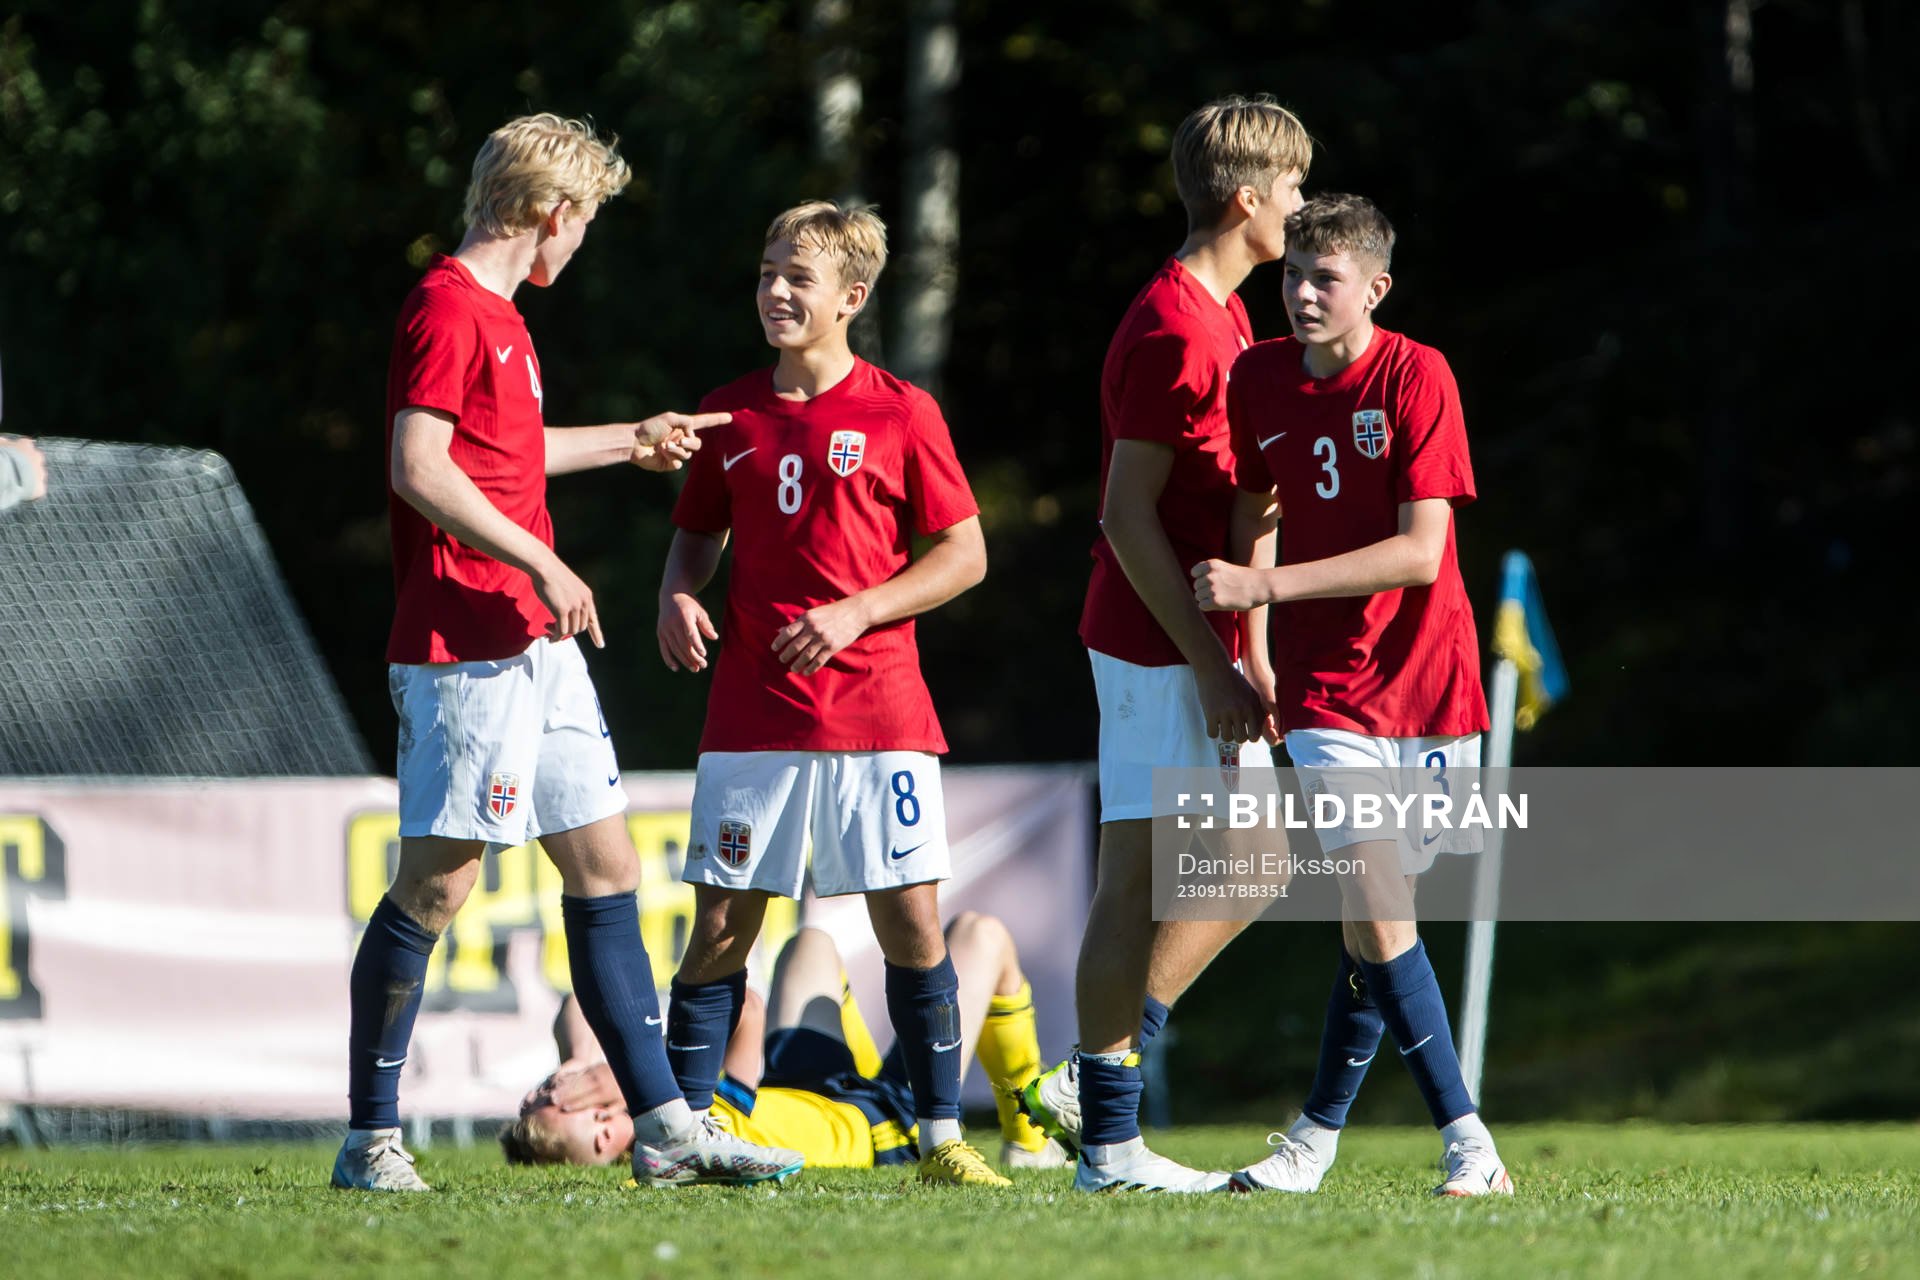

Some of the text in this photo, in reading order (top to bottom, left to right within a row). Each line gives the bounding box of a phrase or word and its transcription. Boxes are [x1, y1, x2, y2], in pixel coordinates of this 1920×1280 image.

[777, 454, 803, 515] 8
[1313, 436, 1340, 499] 3
[891, 770, 920, 827] 8
[1425, 750, 1451, 810] 3
